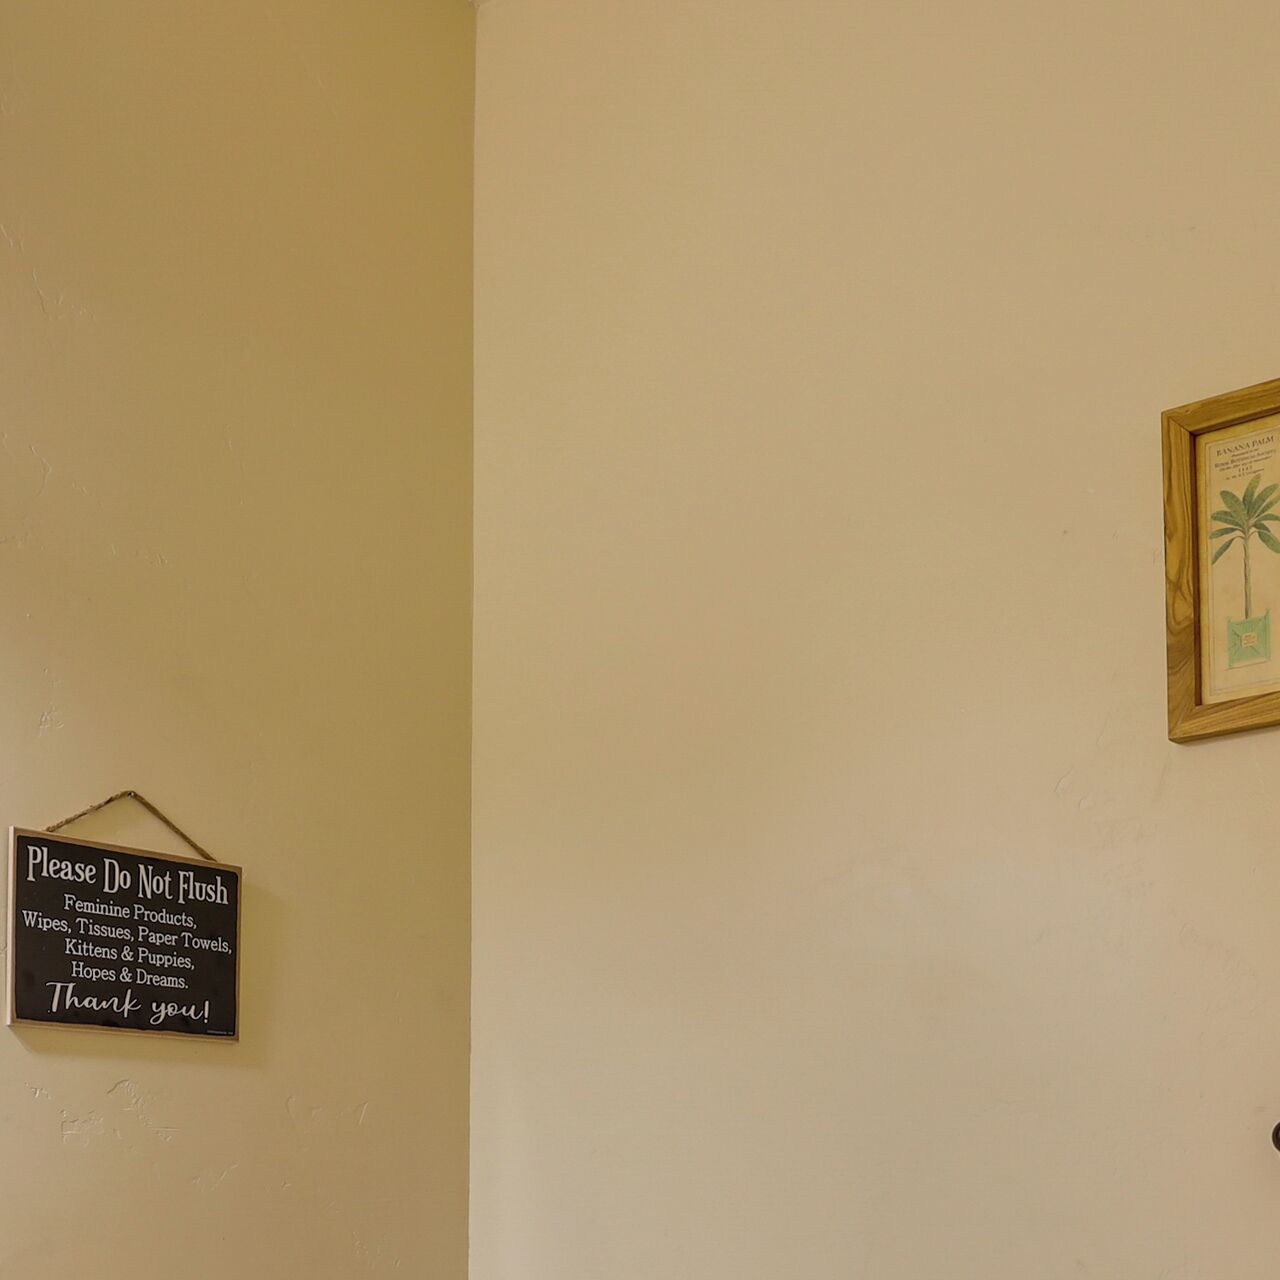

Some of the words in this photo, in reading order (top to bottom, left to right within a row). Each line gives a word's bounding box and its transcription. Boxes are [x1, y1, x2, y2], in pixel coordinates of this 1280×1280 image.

[26, 845, 97, 884] Please
[103, 858, 131, 894] Do
[138, 863, 173, 900] Not
[178, 870, 229, 905] Flush
[64, 893, 131, 920] Feminine
[133, 904, 197, 929] Products,
[22, 910, 72, 934] Wipes,
[75, 917, 135, 941] Tissues,
[138, 927, 178, 948] Paper
[181, 932, 233, 954] Towels,
[64, 938, 117, 960] Kittens
[120, 945, 134, 961] &
[138, 950, 195, 970] Puppies,
[71, 960, 116, 982] Hopes
[120, 967, 133, 983] &
[135, 968, 189, 989] Dreams.
[46, 981, 142, 1018] Thank
[149, 999, 210, 1025] you!
